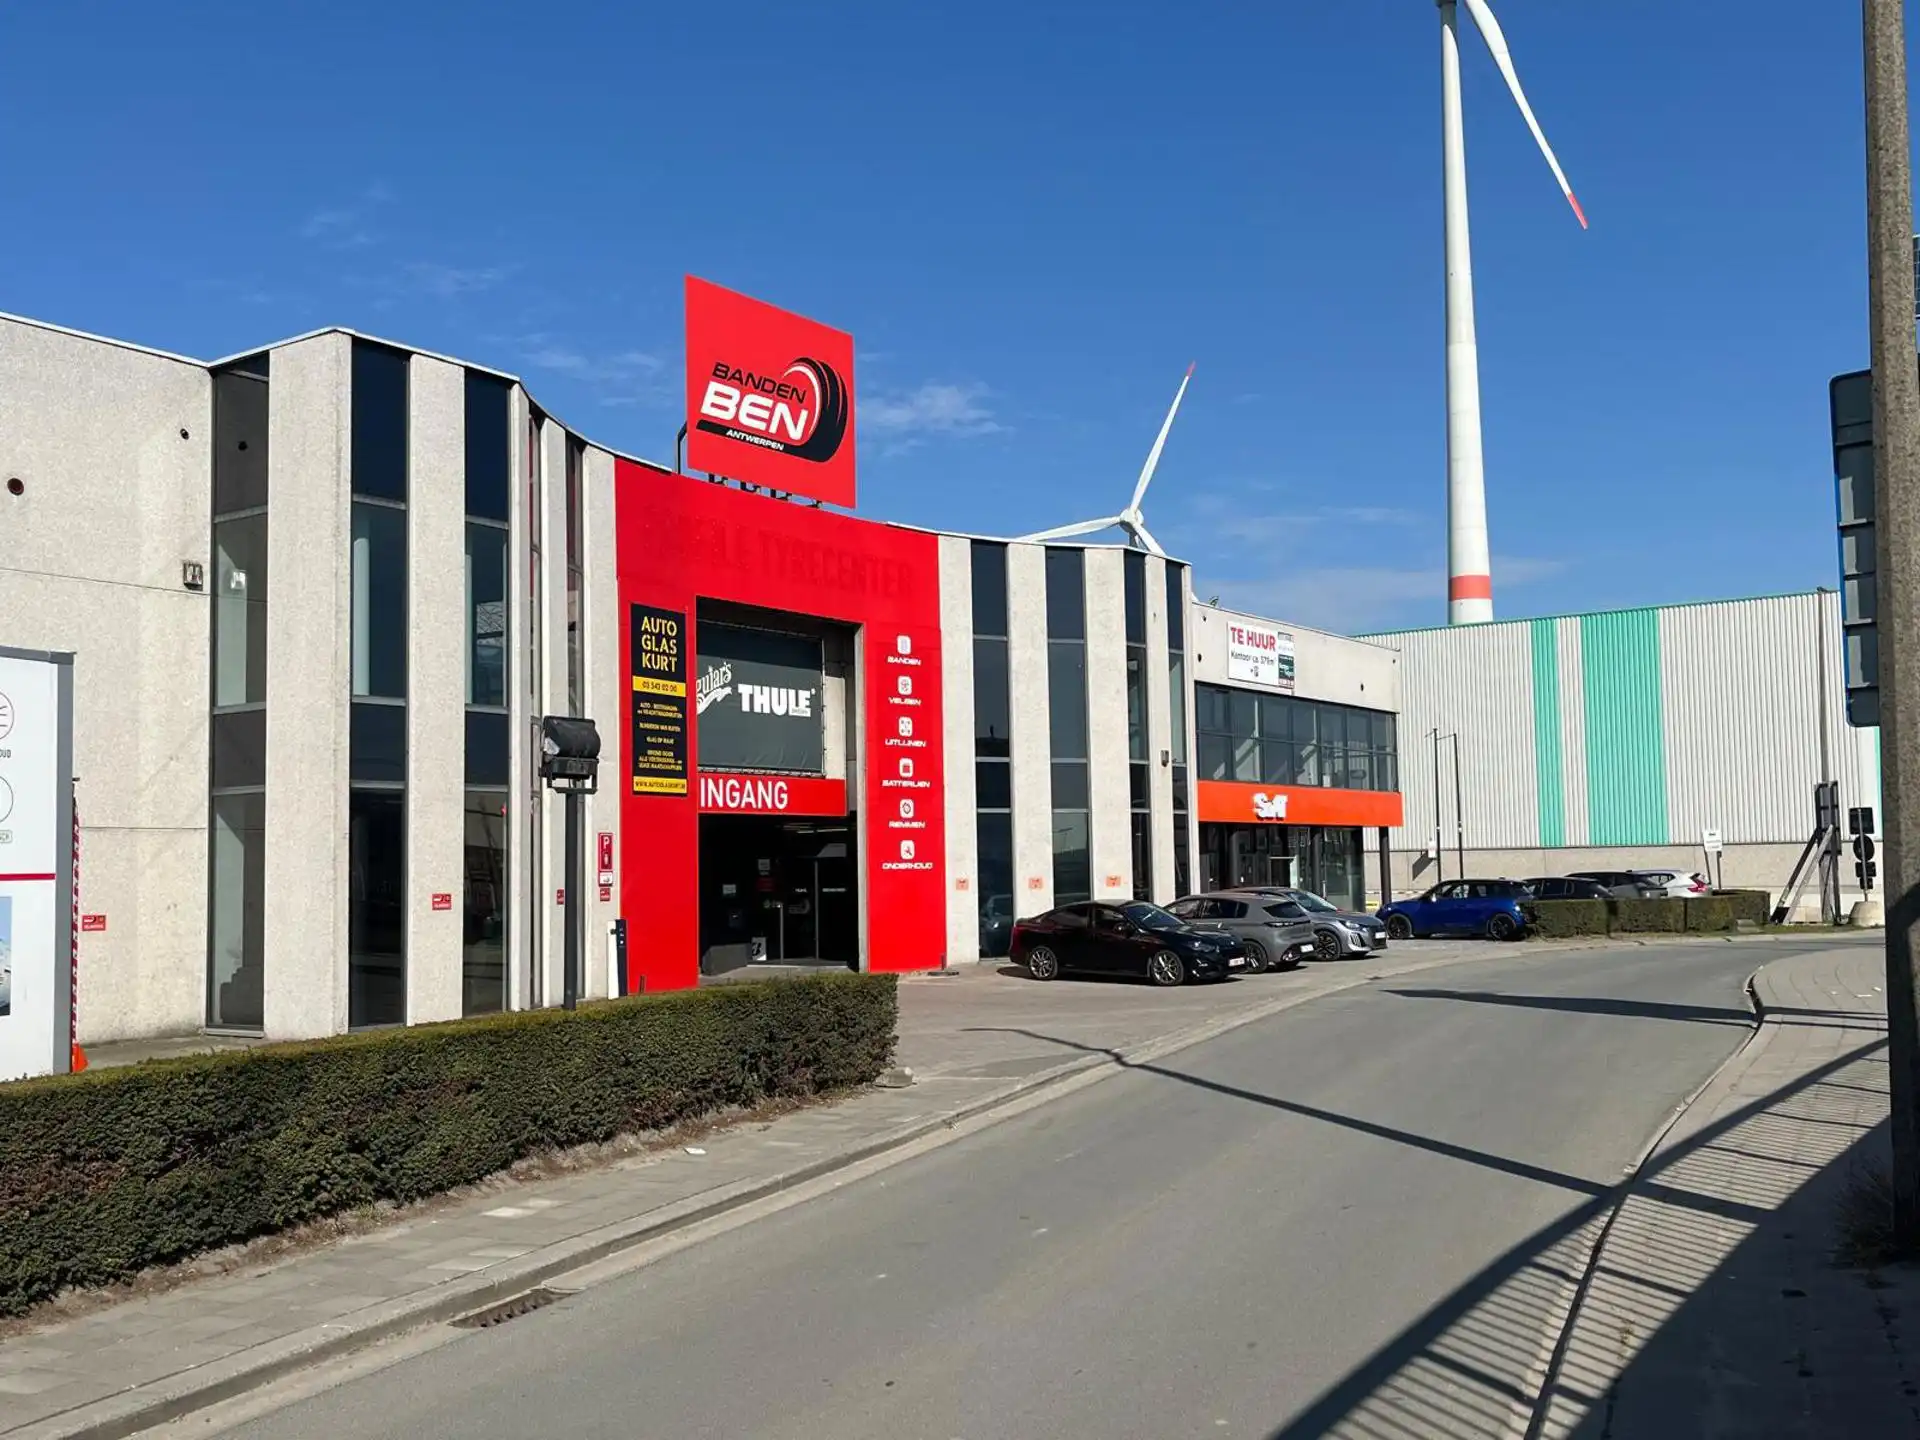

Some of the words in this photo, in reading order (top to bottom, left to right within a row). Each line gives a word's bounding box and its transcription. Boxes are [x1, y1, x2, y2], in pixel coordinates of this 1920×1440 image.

[712, 362, 807, 404] BANDEN
[700, 381, 809, 441] BEN
[726, 429, 784, 451] ANTWERPEN
[641, 616, 677, 636] AUTO
[641, 634, 677, 655] GLAS
[1230, 627, 1244, 645] TE
[1246, 630, 1276, 652] HUUR
[642, 652, 677, 672] KURT
[887, 655, 921, 666] BANDEN
[738, 683, 811, 717] THULE
[700, 777, 788, 810] INGANG
